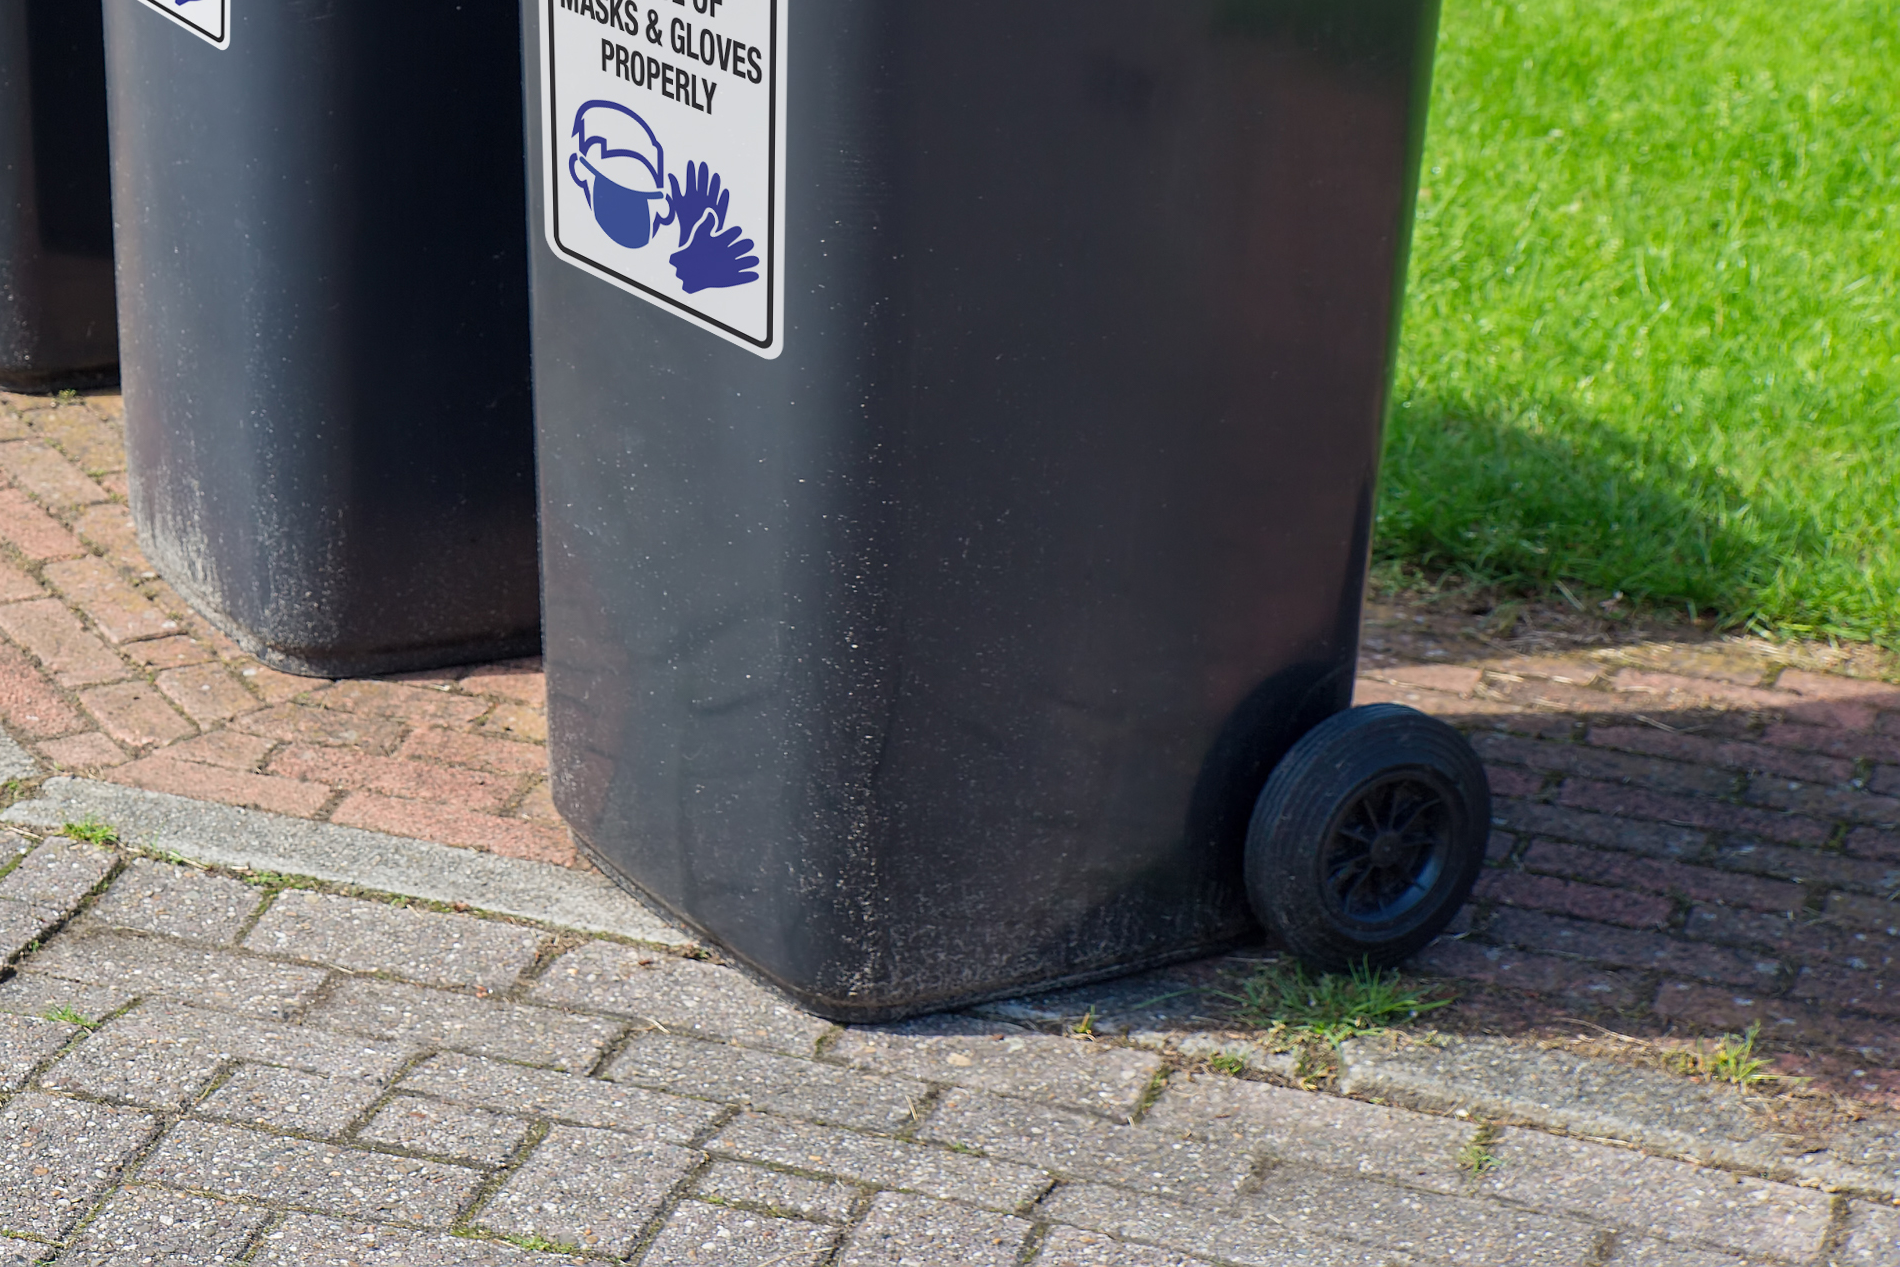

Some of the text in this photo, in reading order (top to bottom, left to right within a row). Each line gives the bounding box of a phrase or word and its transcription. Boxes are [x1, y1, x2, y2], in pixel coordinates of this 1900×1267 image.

[601, 37, 718, 115] PROPERLY
[645, 8, 663, 47] &
[670, 17, 763, 85] GLOVES
